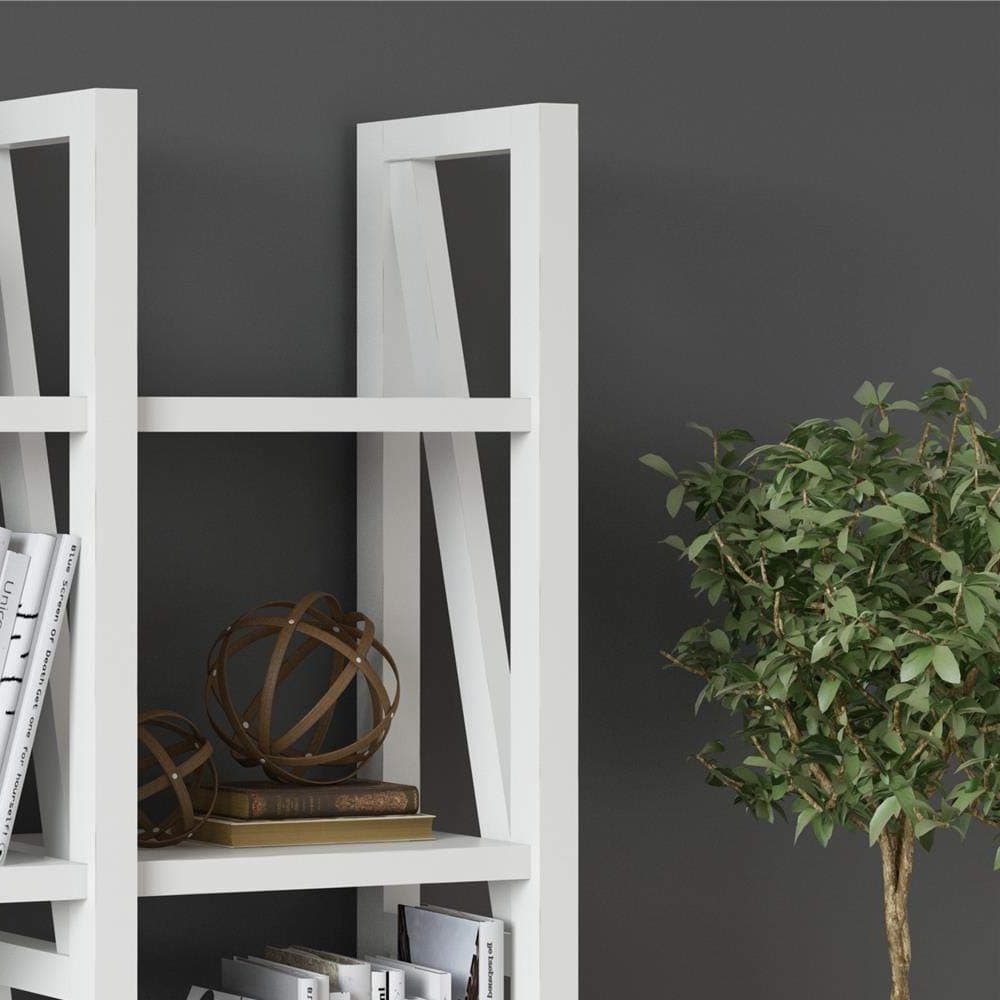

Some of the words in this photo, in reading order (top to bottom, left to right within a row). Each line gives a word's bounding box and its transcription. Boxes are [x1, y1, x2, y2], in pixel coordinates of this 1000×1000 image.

[66, 545, 77, 573] Blue
[54, 580, 68, 622] Screen
[39, 650, 52, 685] Death
[33, 688, 42, 708] Get
[26, 716, 34, 738] one
[20, 746, 29, 767] for
